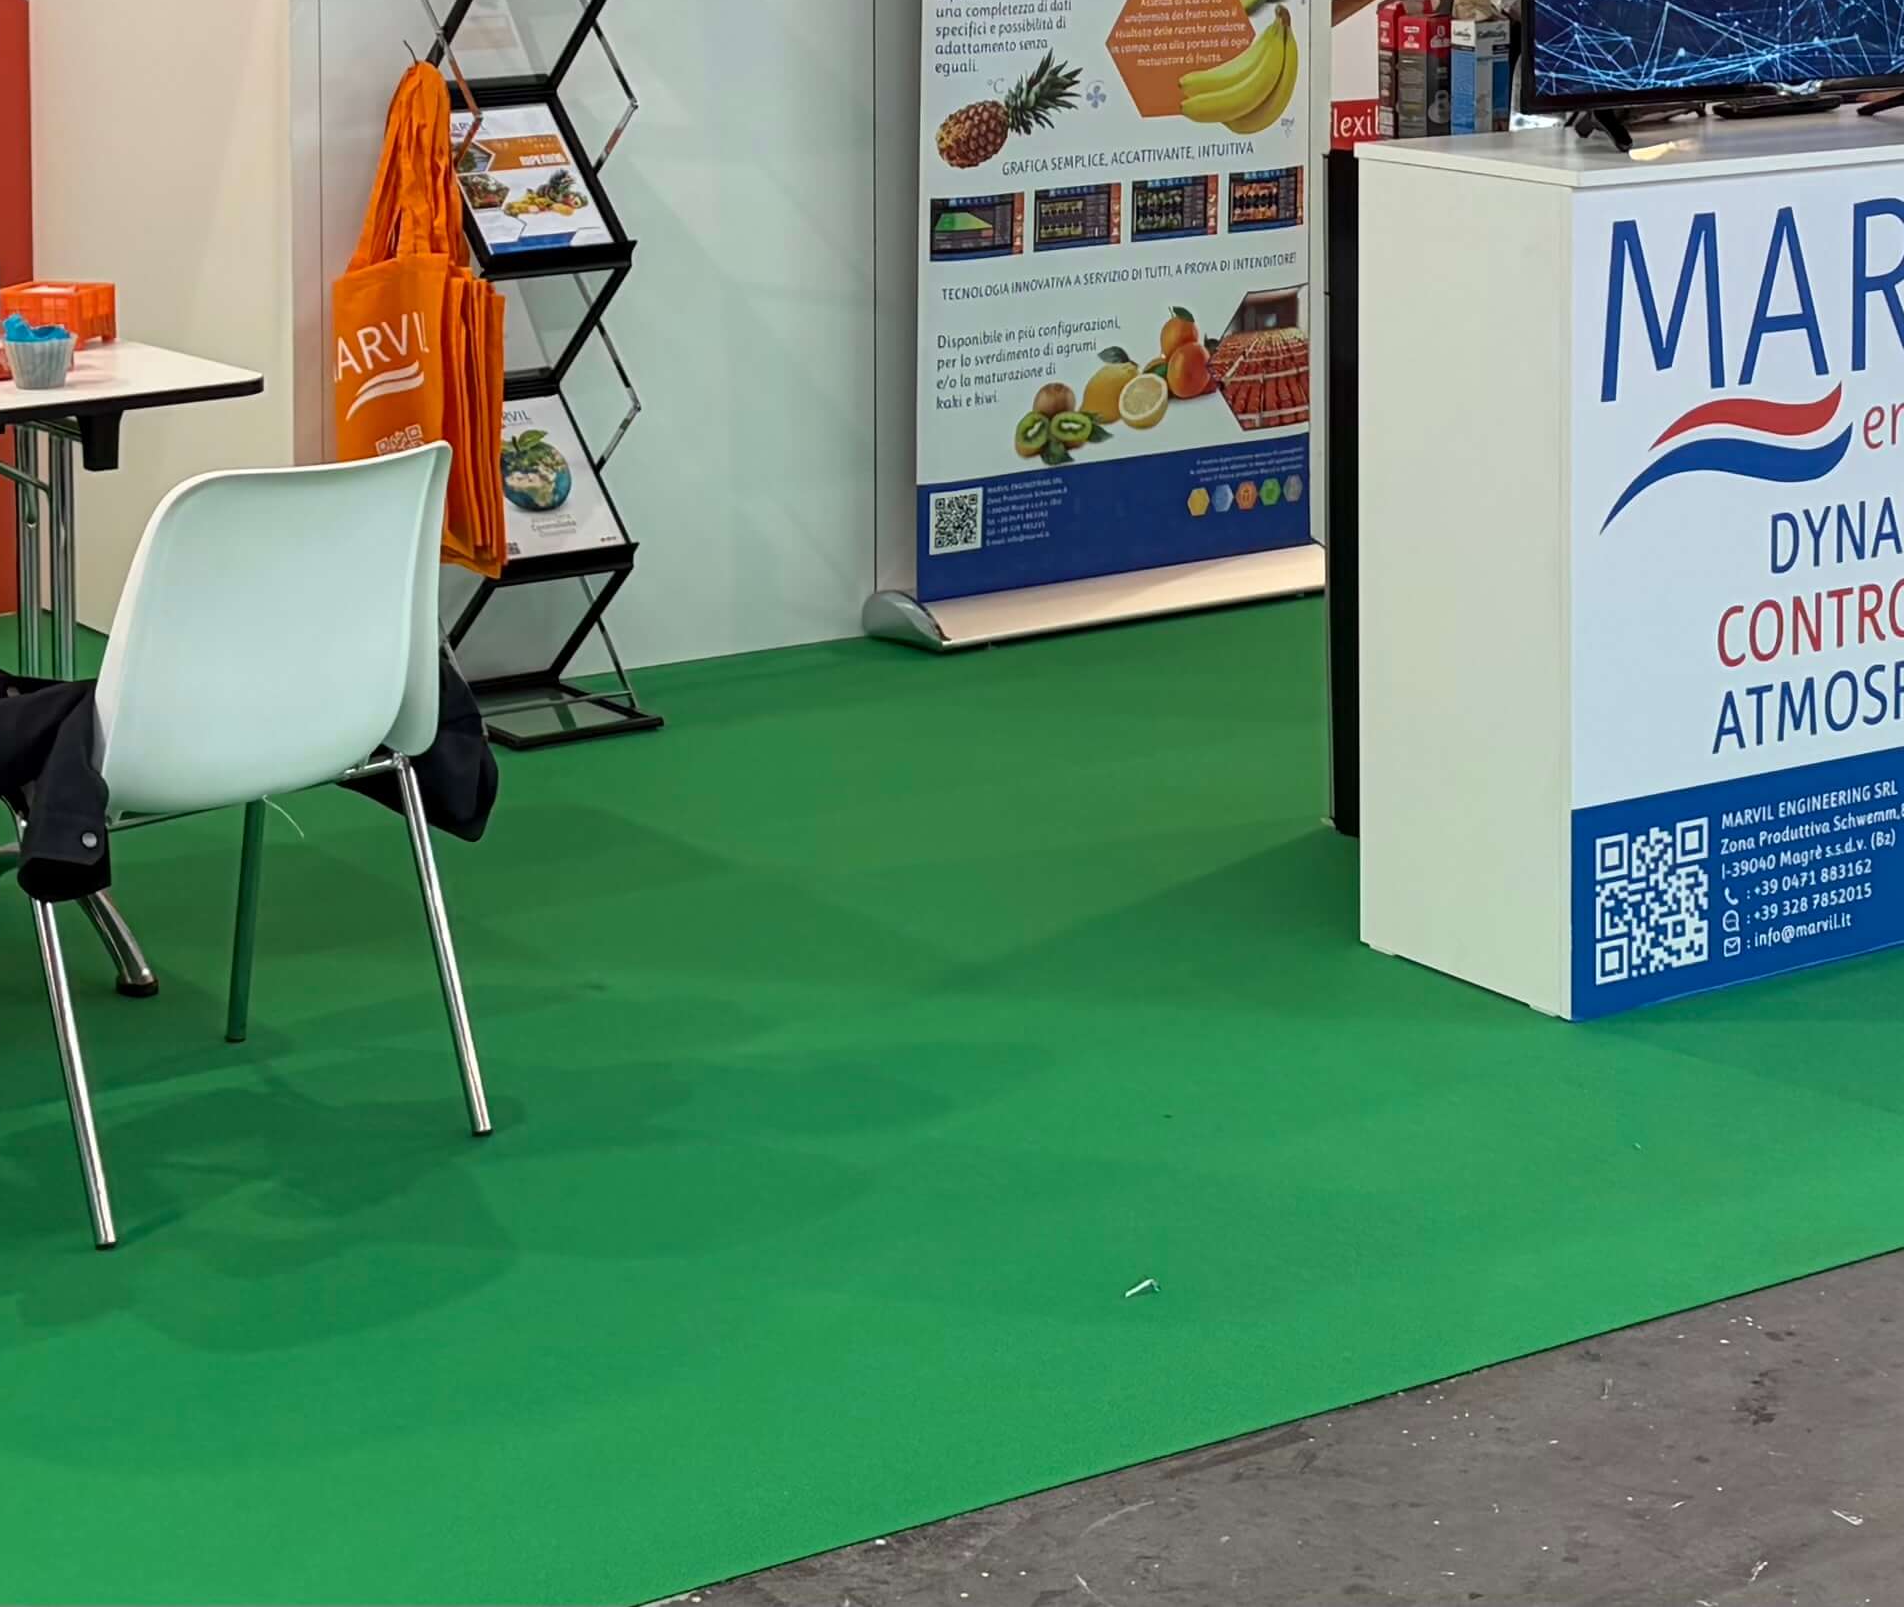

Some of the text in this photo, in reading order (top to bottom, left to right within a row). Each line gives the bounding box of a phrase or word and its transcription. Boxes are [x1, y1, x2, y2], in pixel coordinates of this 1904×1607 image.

[936, 8, 961, 17] una
[966, 4, 1034, 19] completezza
[1038, 0, 1048, 12] di
[936, 16, 1066, 39] specifici e possibilità di
[935, 38, 1048, 55] adattamento senza
[1002, 142, 1254, 176] GRAFICA SEMPLICE, ACCATTIVANTE, INTUITIVA
[942, 282, 1009, 301] TECNOLOGIA
[1011, 276, 1072, 293] INNOVATIVA
[1073, 275, 1081, 287] A
[1084, 269, 1129, 286] SERVIZIO
[1132, 267, 1142, 280] DI
[1175, 263, 1183, 275] A
[1185, 259, 1218, 275] PROVA
[1220, 258, 1230, 271] DI
[937, 330, 1015, 350] Disponibile in
[937, 339, 1096, 371] per lo sverdimento di agrumi
[937, 363, 1056, 390] e/o la maturazione di
[936, 394, 973, 410] kaki e
[1722, 780, 1898, 829] MARVIL ENGINEERING SRL
[1720, 837, 1755, 855] Zona
[1760, 822, 1830, 846] Produttiva
[1721, 829, 1896, 879] I-39040 Magrè (Bz)
[1754, 859, 1872, 896] +39 0471 883162
[1754, 883, 1872, 921] +39 328 7852015
[1754, 913, 1852, 947] info@marvil.it
